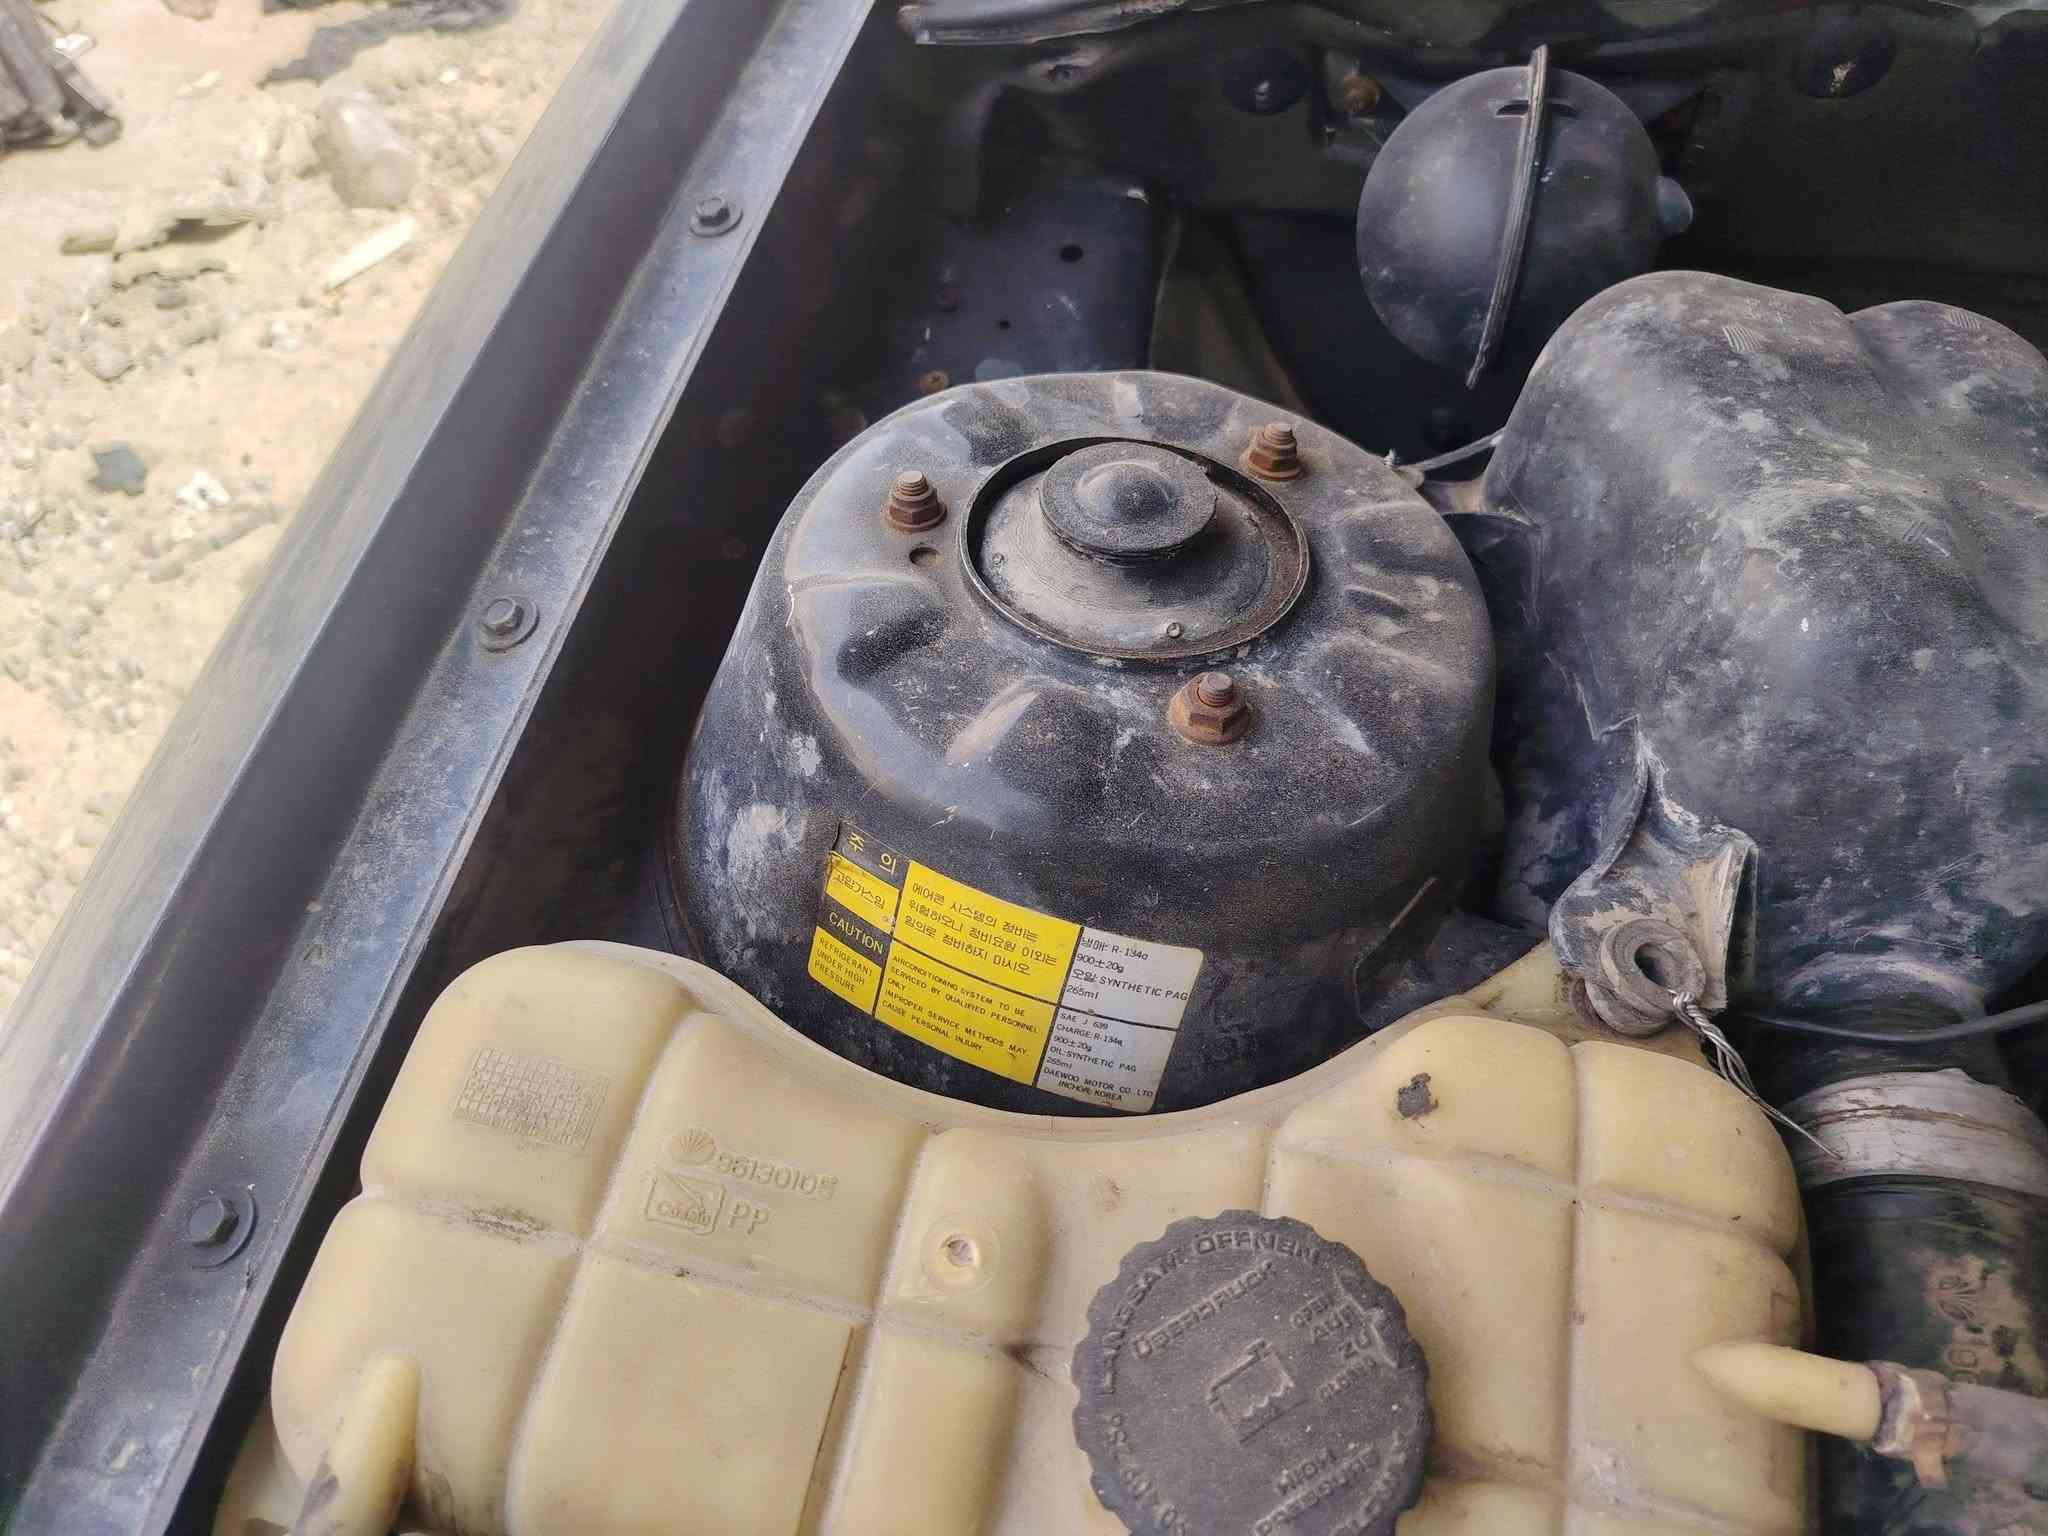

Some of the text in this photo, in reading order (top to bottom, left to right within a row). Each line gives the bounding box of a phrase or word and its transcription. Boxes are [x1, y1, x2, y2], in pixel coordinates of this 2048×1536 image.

[829, 911, 884, 955] CAUTION
[909, 899, 1057, 966] 위험하오니 정비요원 이외는
[950, 902, 998, 927] 시스템의
[1003, 922, 1039, 942] 정비는
[819, 936, 872, 976] REFRIGERANT
[905, 916, 1031, 975] 임의로 정비하지 마시오
[815, 960, 855, 992] PRESSURE
[817, 949, 864, 984] UNDER HIGH
[1076, 953, 1124, 973] 900±20g
[888, 977, 905, 991] ONLY
[891, 966, 1038, 1033] SERVICED BY QUALIFIED PERSONNEL
[1066, 985, 1099, 1000] 265ml
[882, 999, 905, 1017] CAUSE
[912, 1015, 949, 1038] PERSONAL
[886, 988, 923, 1013] IMPROPER
[928, 1010, 960, 1030] SERVICE
[965, 1027, 1004, 1047] METHODS
[961, 988, 992, 1004] SYSTEM
[1000, 1002, 1009, 1011] TO
[1015, 1008, 1024, 1016] BE
[1060, 1012, 1077, 1022] SAE
[1043, 1067, 1080, 1082] DAEWOO
[1084, 1079, 1114, 1091] MOTOR
[1119, 1064, 1136, 1072] PAG
[1095, 1087, 1122, 1100] KOREA
[729, 1200, 772, 1234] PP
